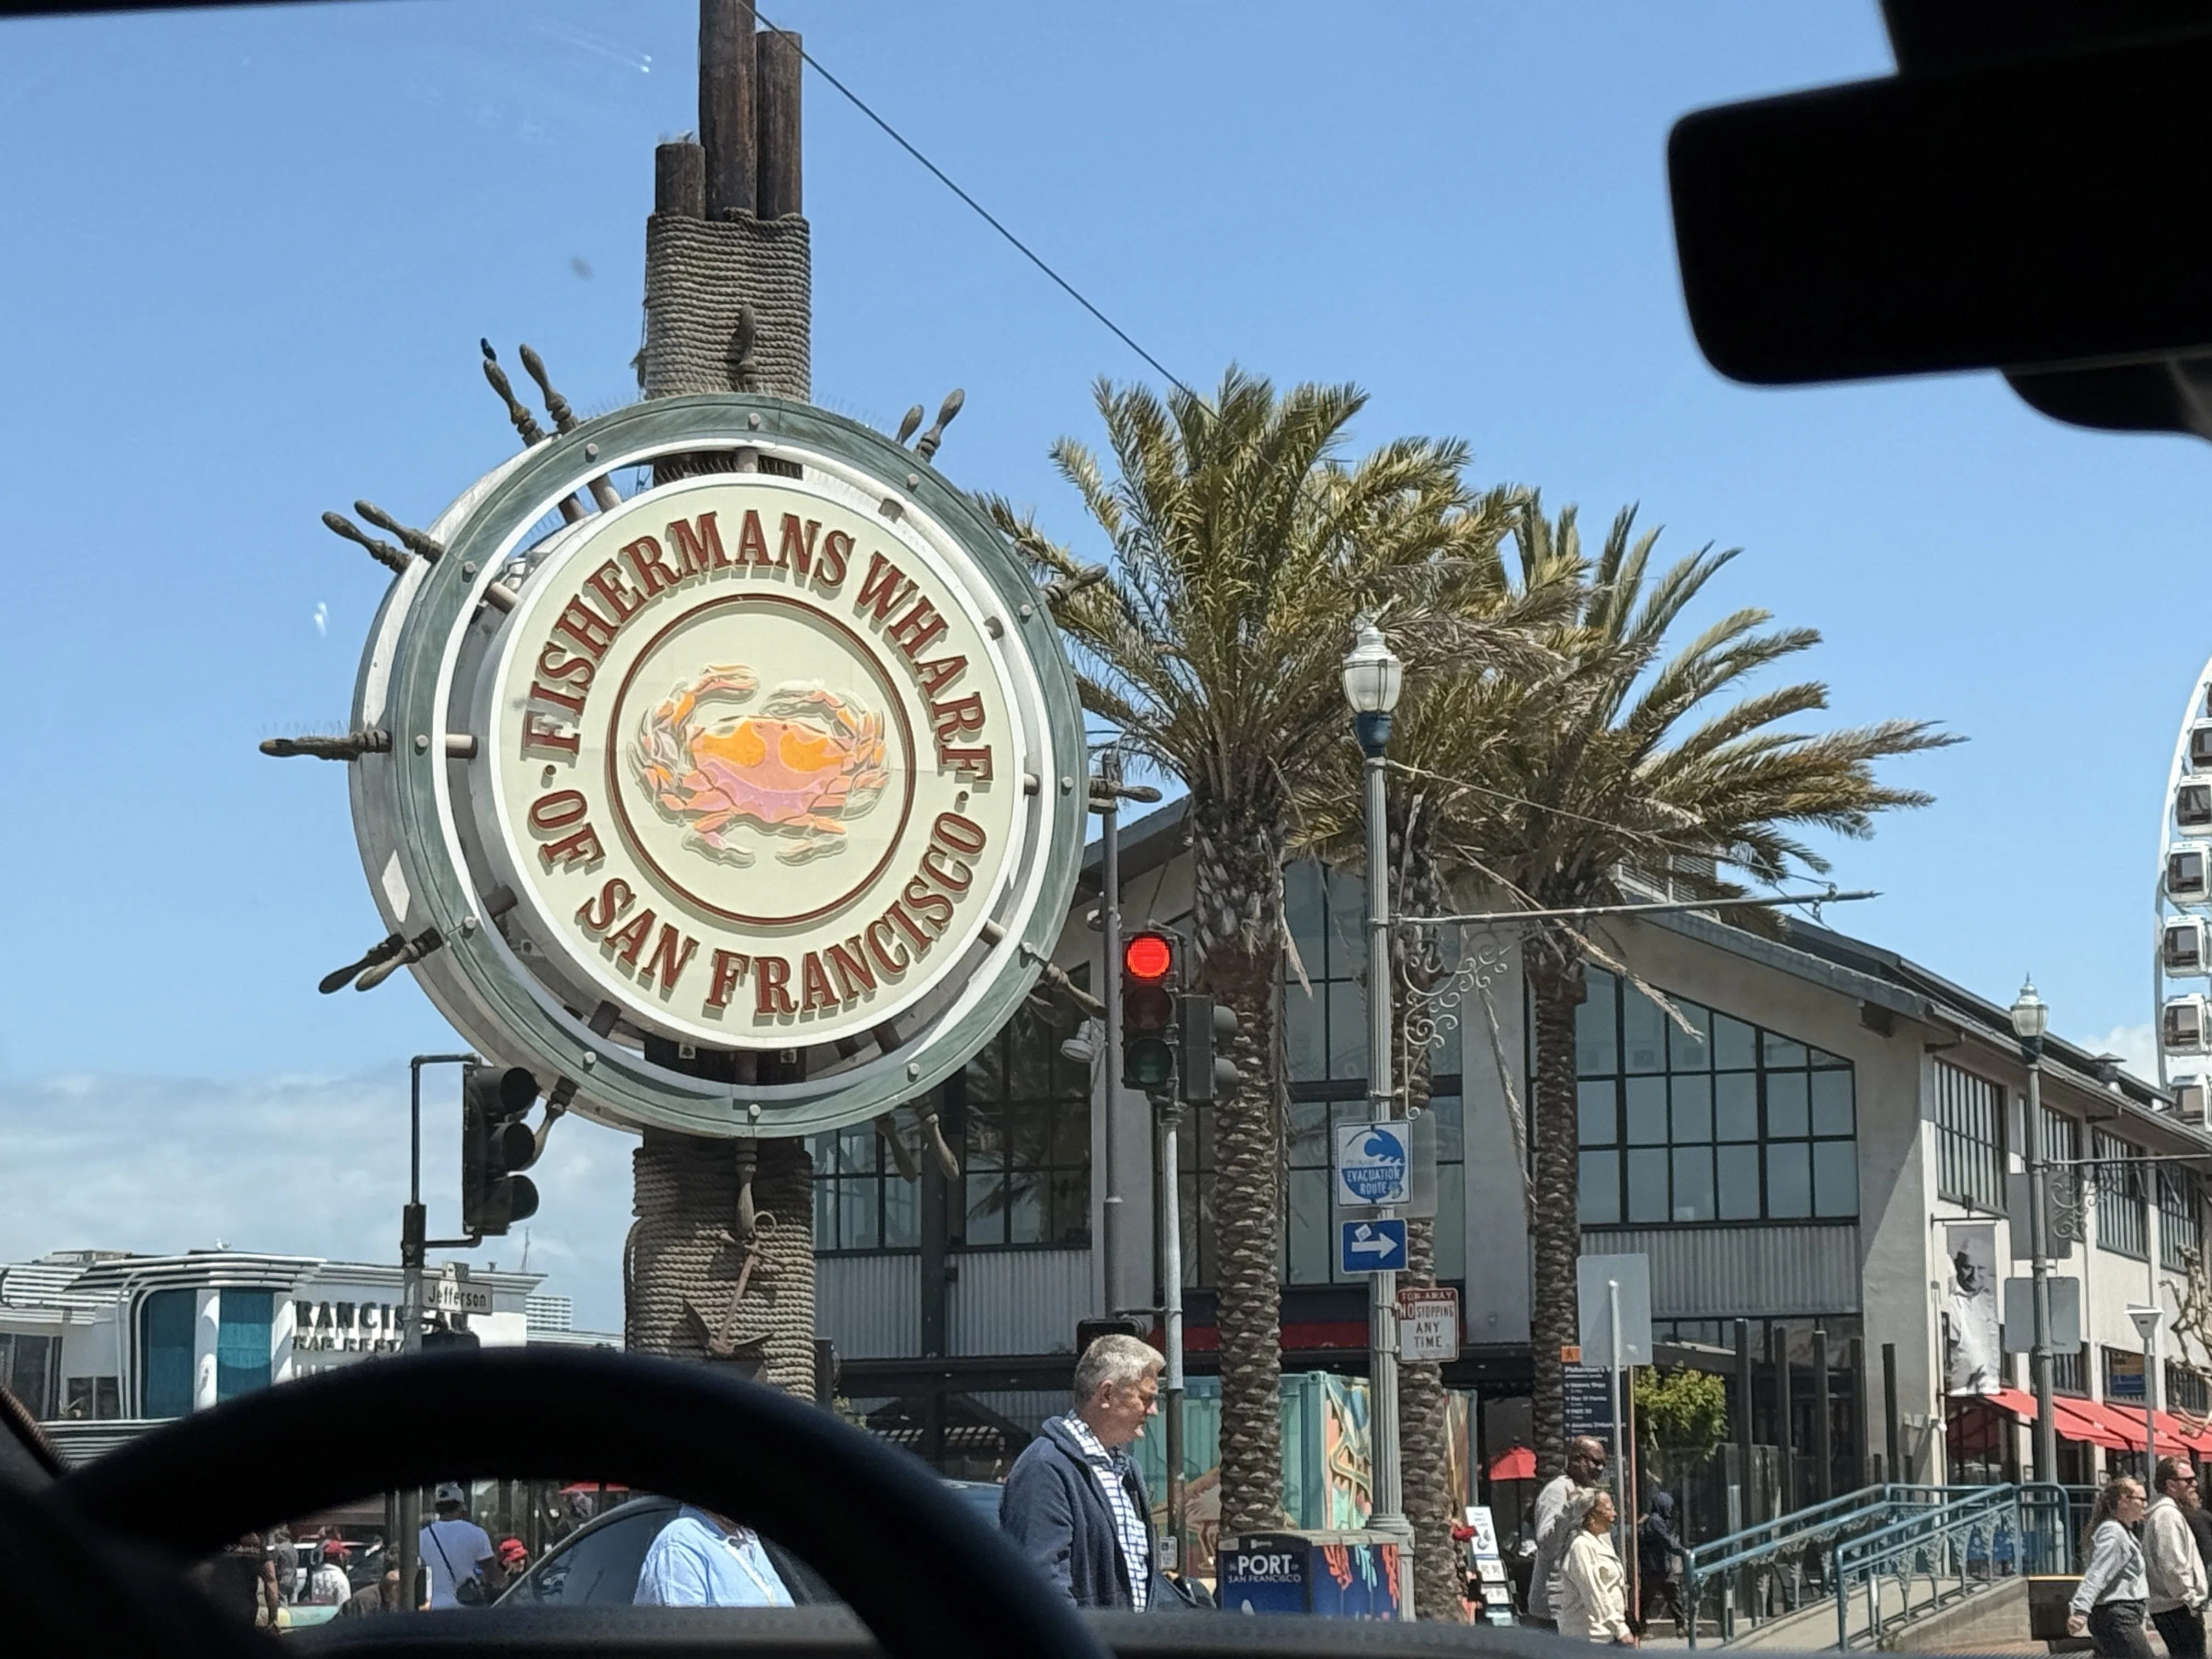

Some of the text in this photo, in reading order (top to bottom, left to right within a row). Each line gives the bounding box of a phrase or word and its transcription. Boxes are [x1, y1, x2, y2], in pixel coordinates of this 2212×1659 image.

[521, 509, 994, 781] FISHERMANS WHARF
[529, 788, 988, 1019] OF SAN FRANCISCO
[1347, 1169, 1401, 1182] EVACUATION
[1359, 1181, 1387, 1194] ROUTE
[428, 1284, 487, 1308] Jefferson
[1400, 1302, 1454, 1319] NO STOPPING
[1416, 1321, 1440, 1334] ANY
[1414, 1335, 1442, 1348] TIME
[1238, 1554, 1293, 1576] PORT
[1228, 1573, 1302, 1583] SAN FRANCISCO
